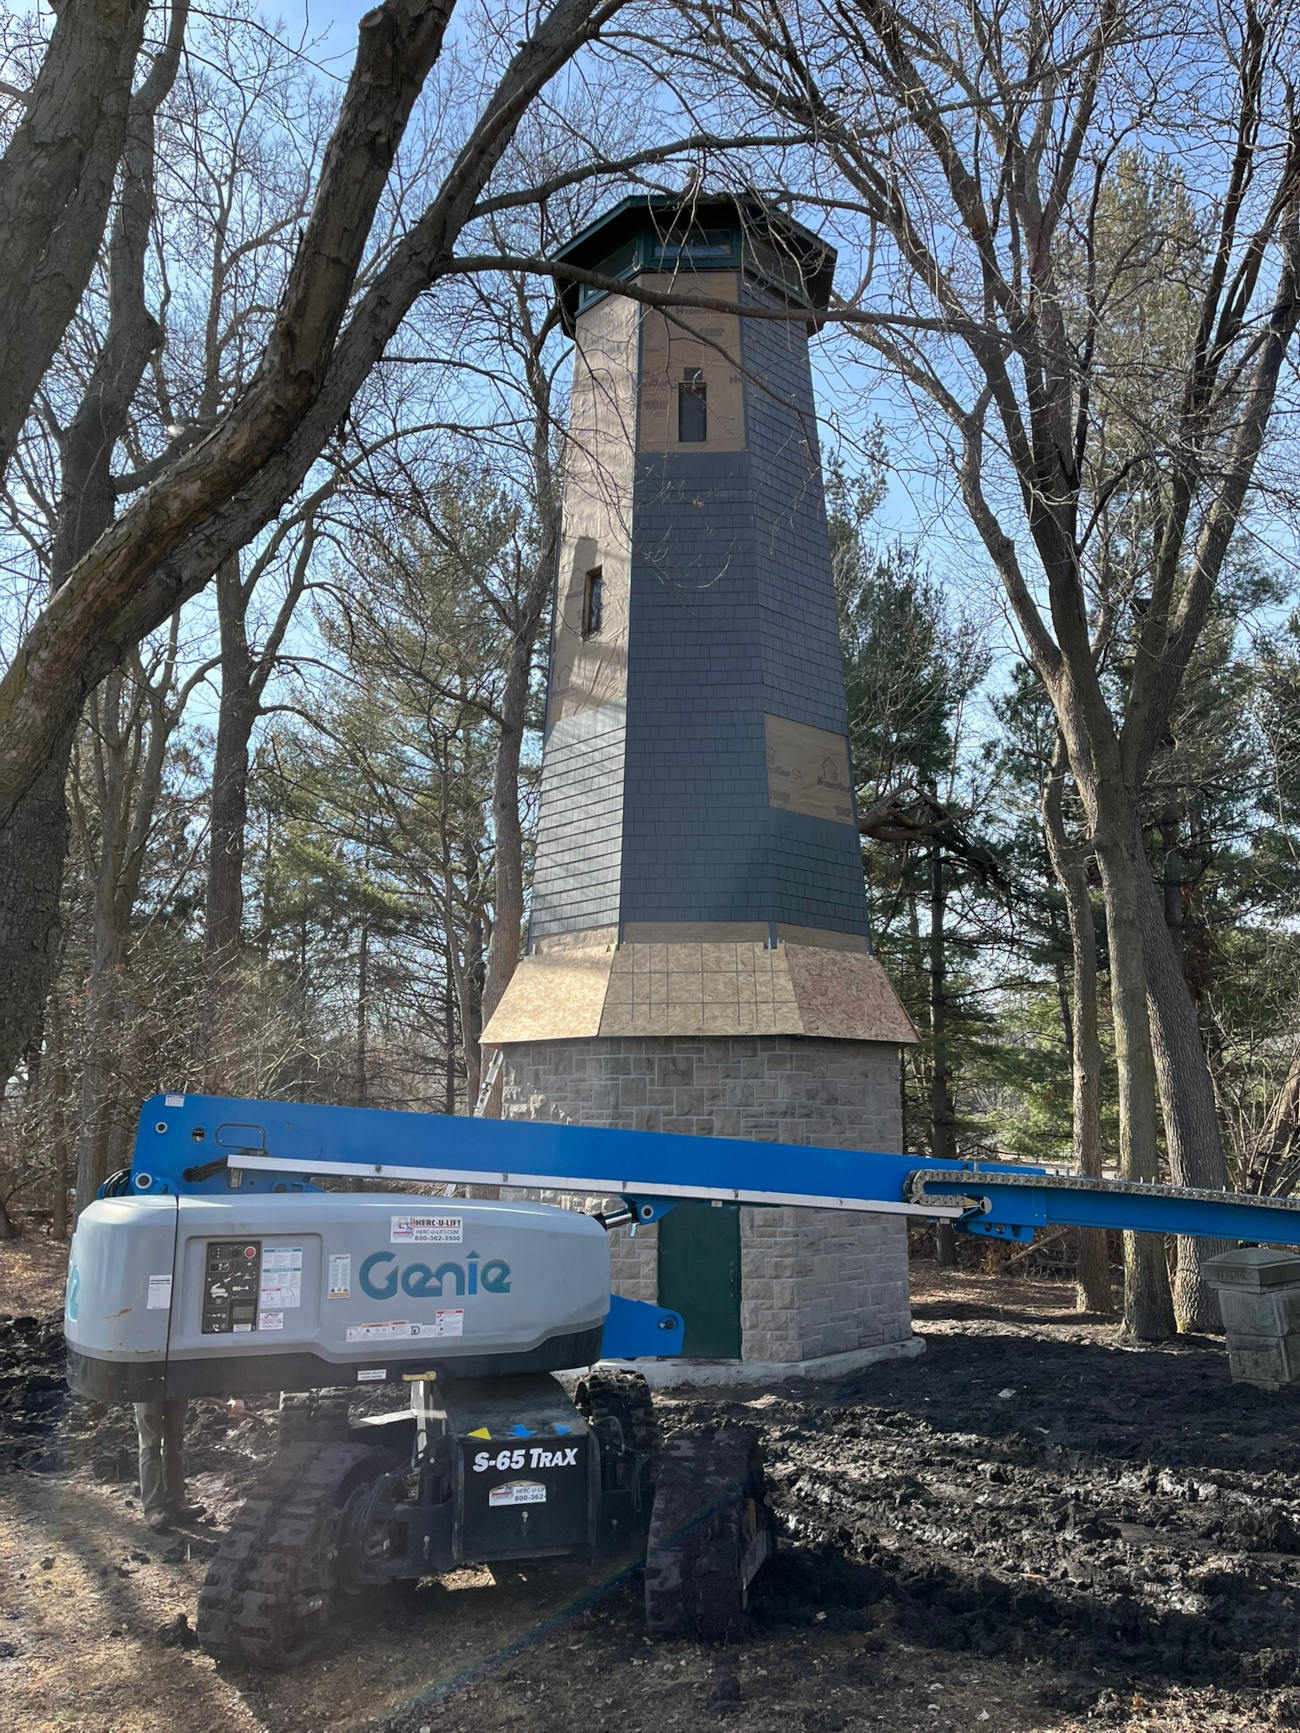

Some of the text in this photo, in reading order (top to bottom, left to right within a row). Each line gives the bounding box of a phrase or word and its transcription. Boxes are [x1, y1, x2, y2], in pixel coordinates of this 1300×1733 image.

[415, 1219, 461, 1227] HERC-U-LIFT
[359, 1250, 512, 1300] Genie
[472, 1449, 526, 1472] S-65
